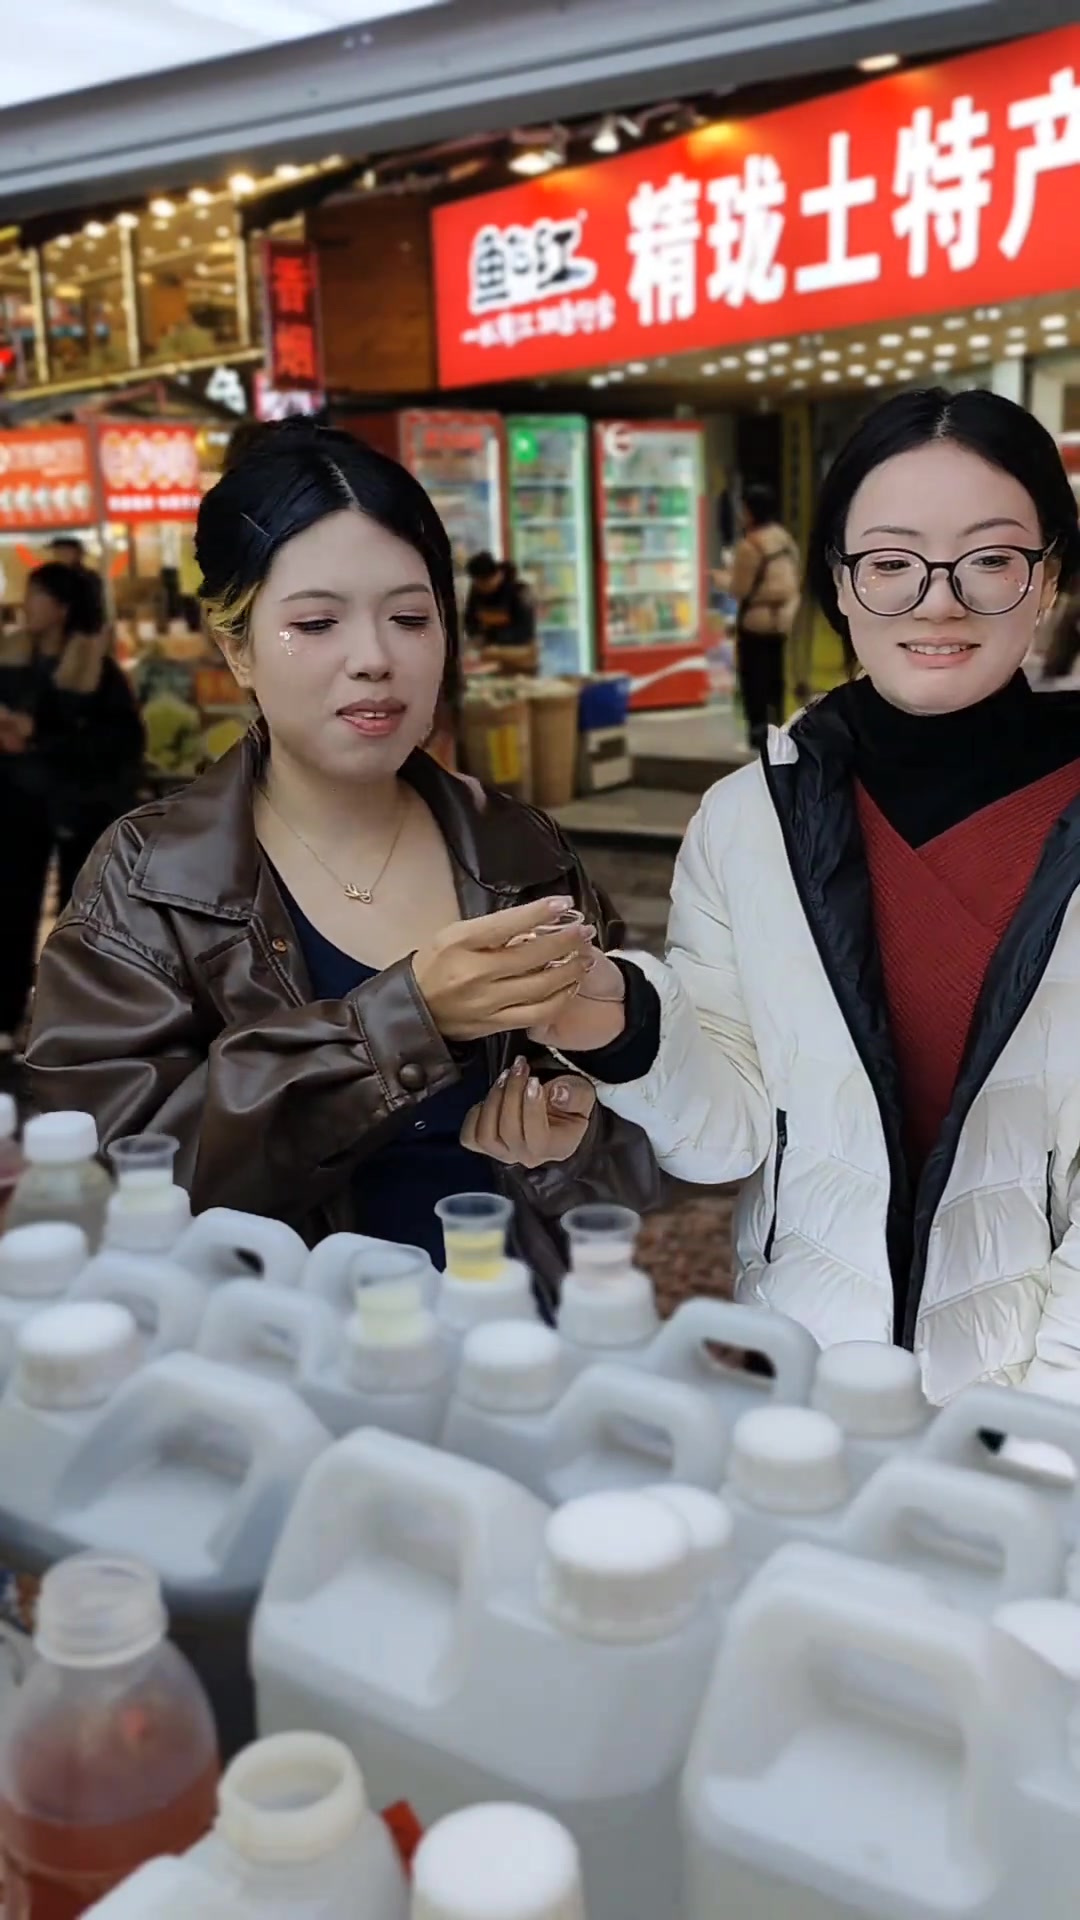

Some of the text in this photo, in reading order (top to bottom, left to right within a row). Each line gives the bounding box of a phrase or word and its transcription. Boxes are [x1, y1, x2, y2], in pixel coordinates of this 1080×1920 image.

[627, 67, 1080, 326] 精珑土特产
